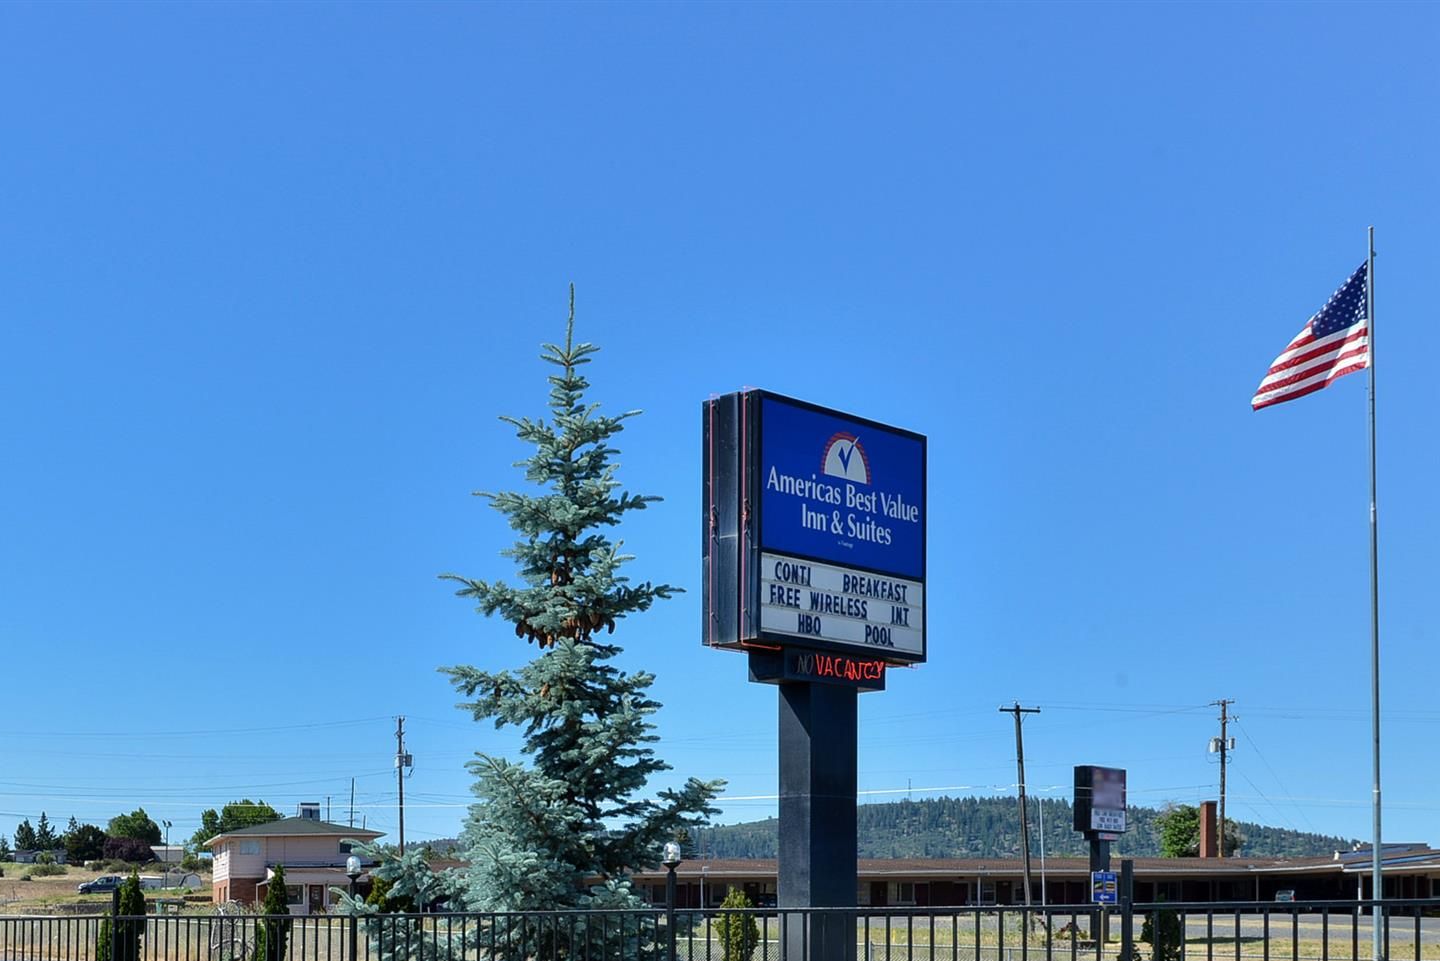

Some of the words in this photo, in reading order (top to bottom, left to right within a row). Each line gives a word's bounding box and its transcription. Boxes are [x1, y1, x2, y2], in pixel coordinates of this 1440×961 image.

[767, 465, 841, 505] Americas
[846, 484, 877, 514] Best
[880, 492, 919, 523] Value
[802, 503, 826, 531] Inn
[831, 510, 844, 535] &
[847, 513, 892, 545] Suites
[770, 584, 801, 609] FREE
[811, 591, 868, 620] WIRELESS
[891, 606, 909, 627] INT
[843, 574, 908, 604] BREAKFAST
[798, 614, 821, 636] HBO
[865, 625, 894, 647] POOL
[797, 655, 812, 674] NO
[815, 654, 885, 680] VACANCY
